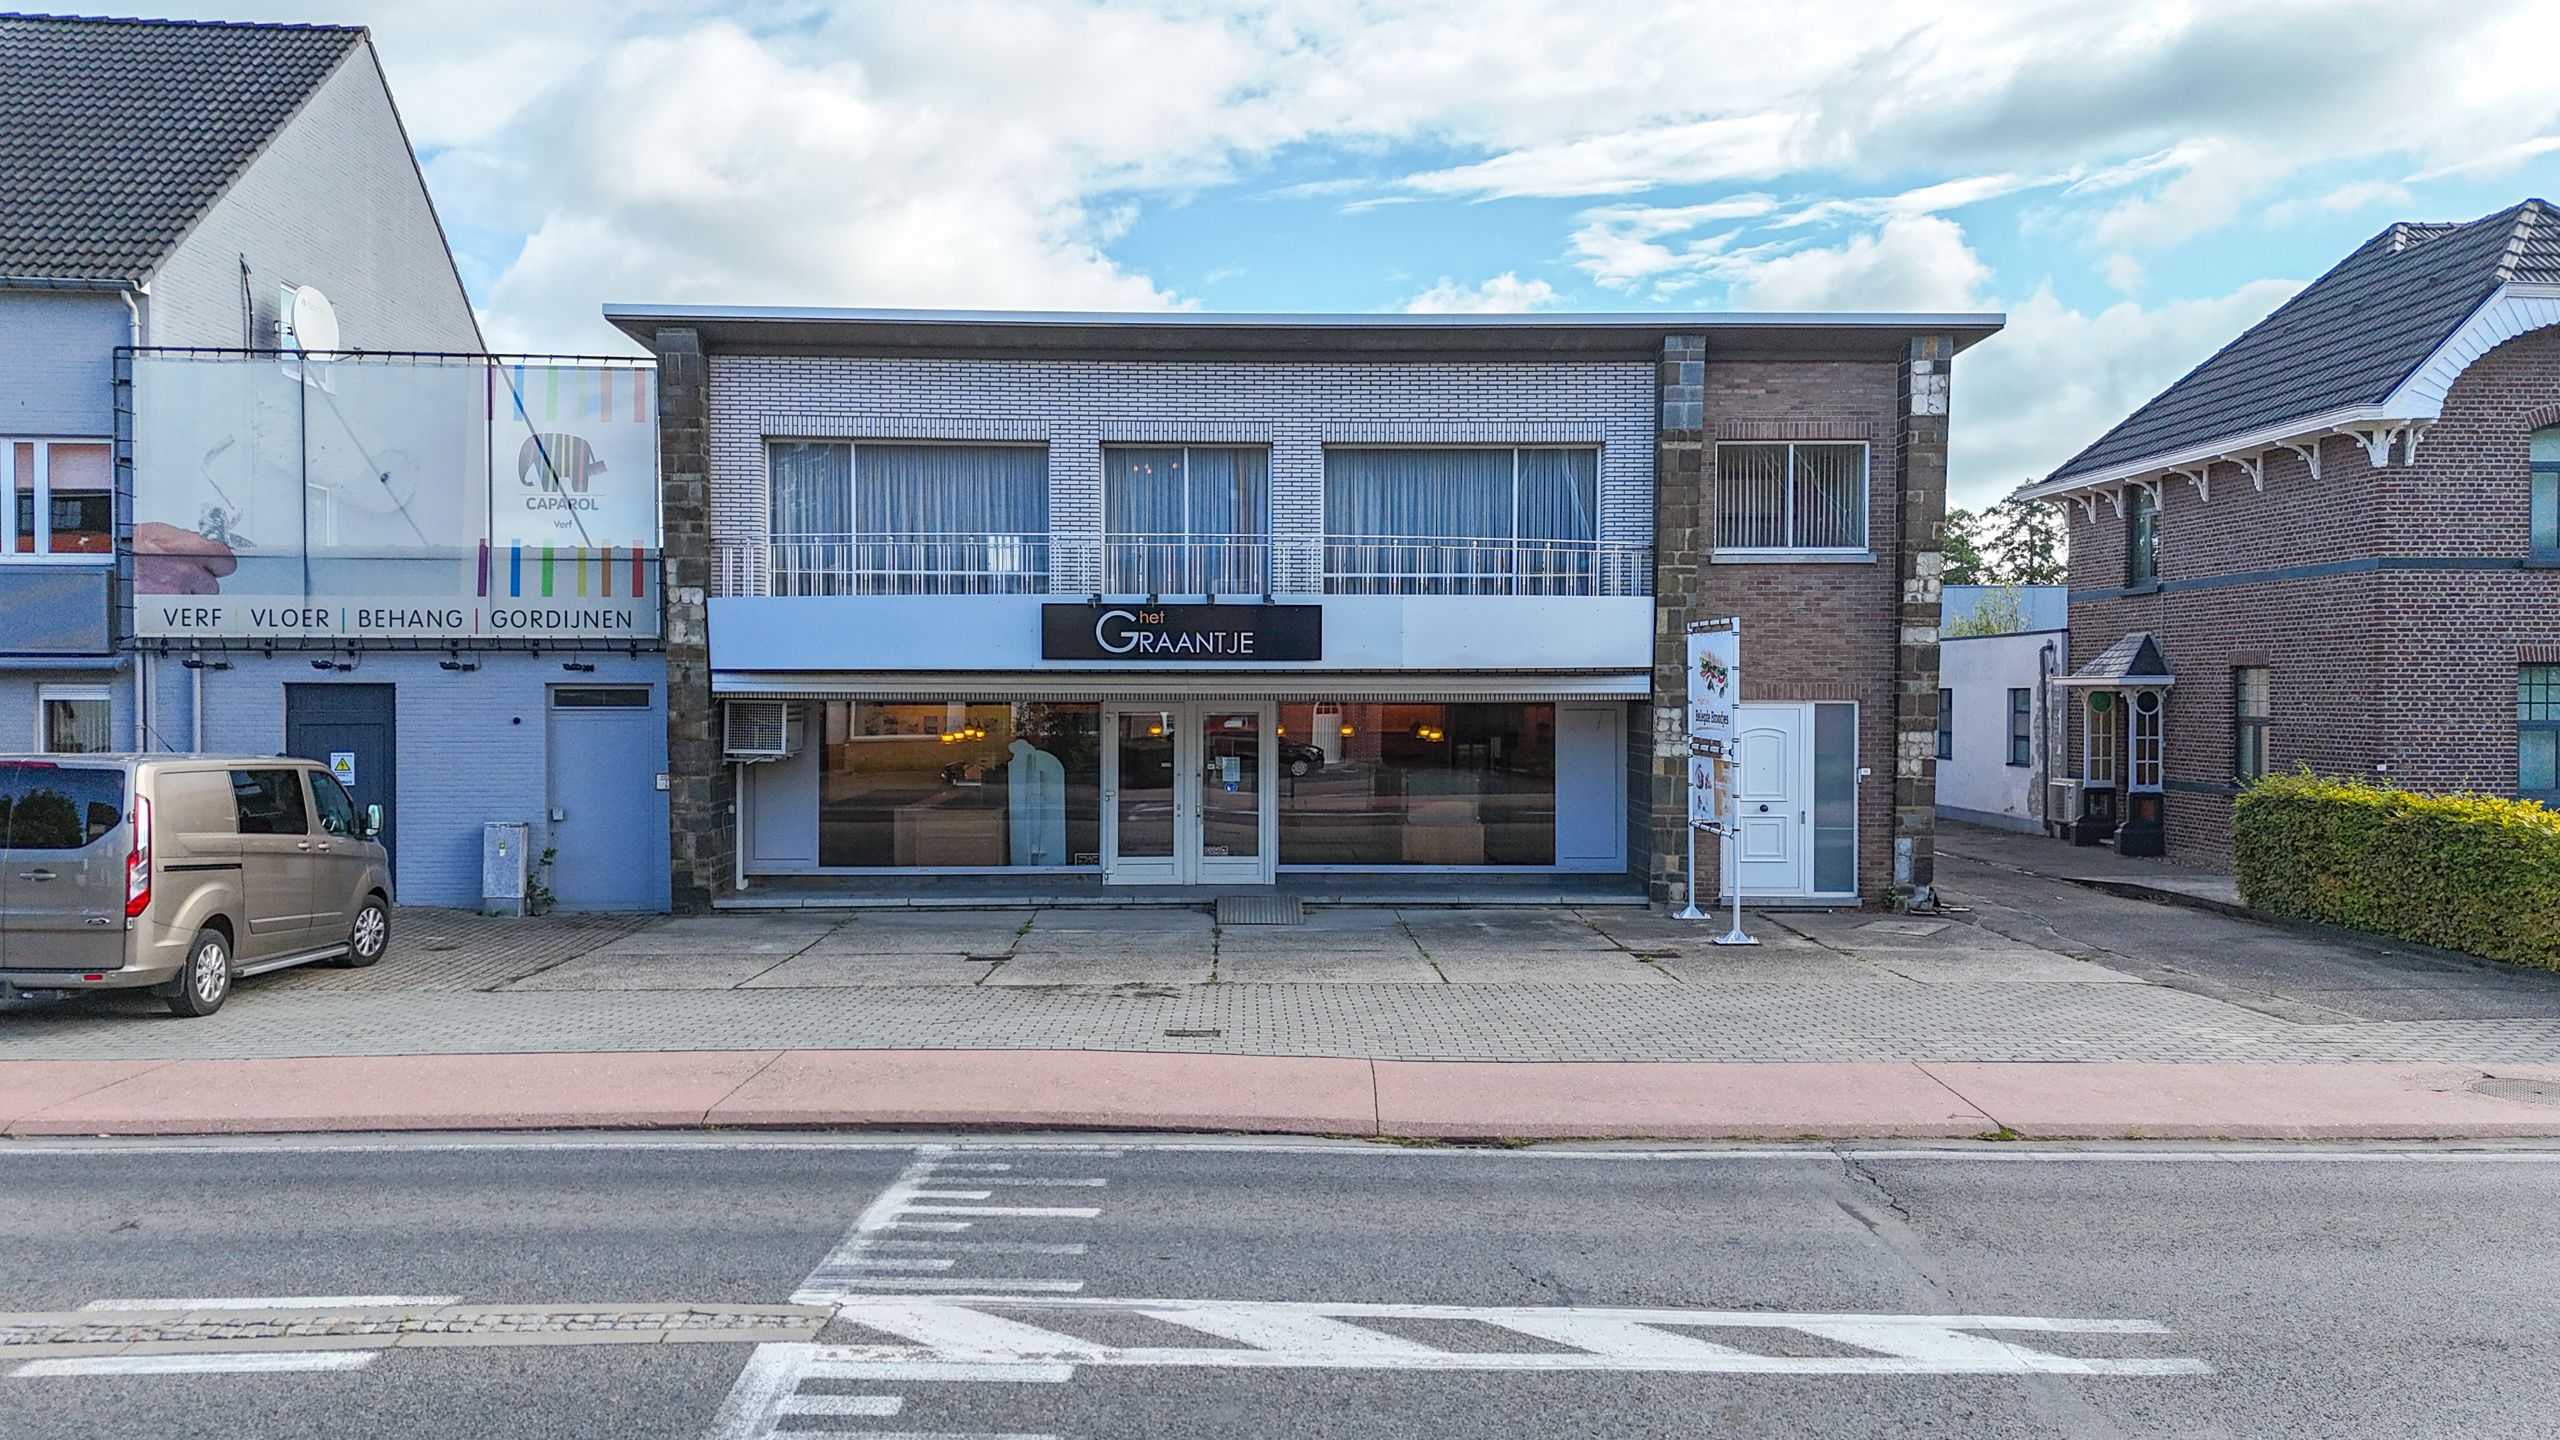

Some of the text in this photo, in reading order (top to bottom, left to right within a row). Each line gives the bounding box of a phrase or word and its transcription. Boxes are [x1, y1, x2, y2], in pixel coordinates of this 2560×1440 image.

[526, 497, 599, 511] CAPAROL
[553, 519, 573, 529] Verf
[163, 608, 632, 629] VERF VLOER BEHANG GORDIJNEN
[1139, 610, 1165, 624] het
[1095, 610, 1254, 654] GRAANTJE
